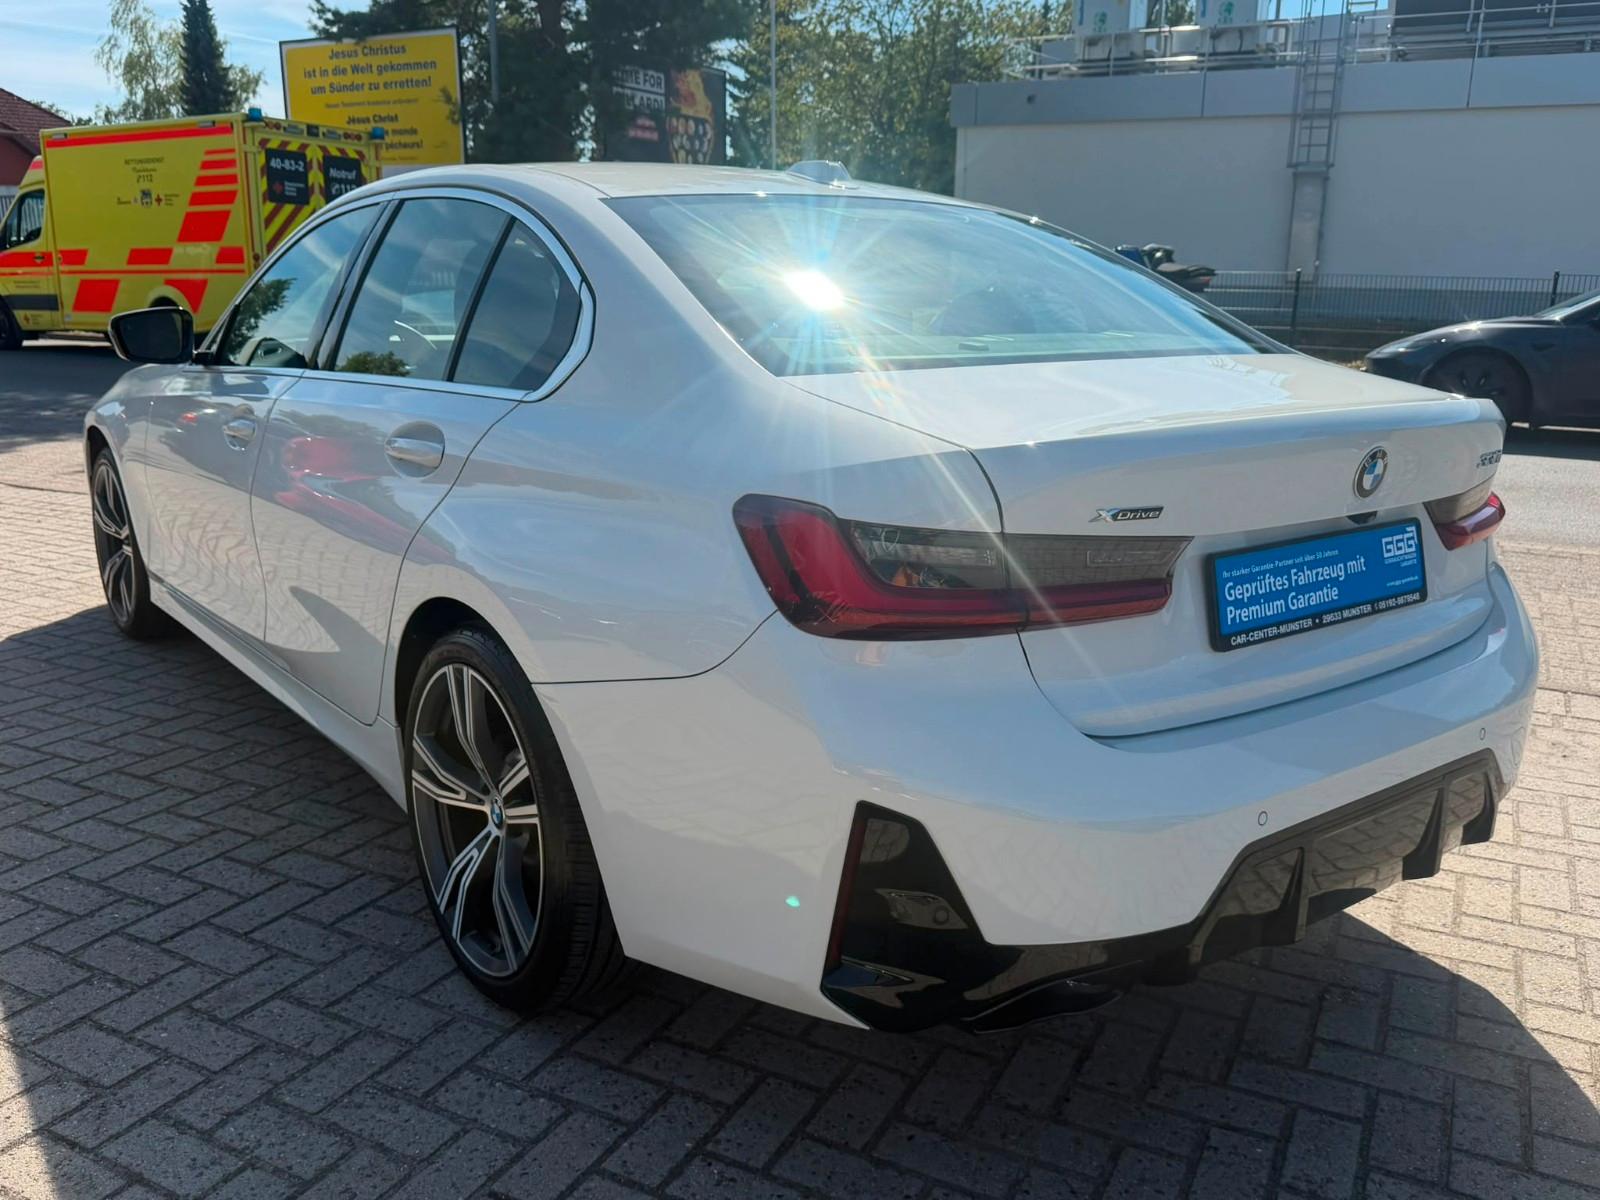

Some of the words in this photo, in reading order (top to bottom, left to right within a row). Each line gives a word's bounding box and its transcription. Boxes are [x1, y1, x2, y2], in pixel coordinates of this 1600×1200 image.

[329, 47, 358, 60] Jesus
[362, 44, 406, 57] Christus
[304, 68, 316, 79] ist
[319, 66, 329, 78] in
[331, 64, 347, 77] die
[351, 62, 374, 75] Welt
[376, 60, 437, 75] gekommen
[311, 86, 326, 95] um
[329, 80, 365, 94] Sünder
[368, 80, 380, 91] zu
[383, 76, 432, 90] erretten!
[643, 72, 663, 90] FOR
[346, 115, 370, 125] Jesus
[372, 112, 399, 123] Christ
[270, 158, 305, 172] 40-83-2
[329, 167, 357, 180] Notruf
[1231, 567, 1251, 577] starker
[1251, 558, 1294, 573] Garantie-Partner
[1224, 572, 1289, 603] Geprüftes
[1291, 563, 1345, 588] Fahrzeug
[1347, 555, 1366, 575] mit
[1226, 599, 1286, 625] Premium
[1288, 584, 1339, 610] Garantie
